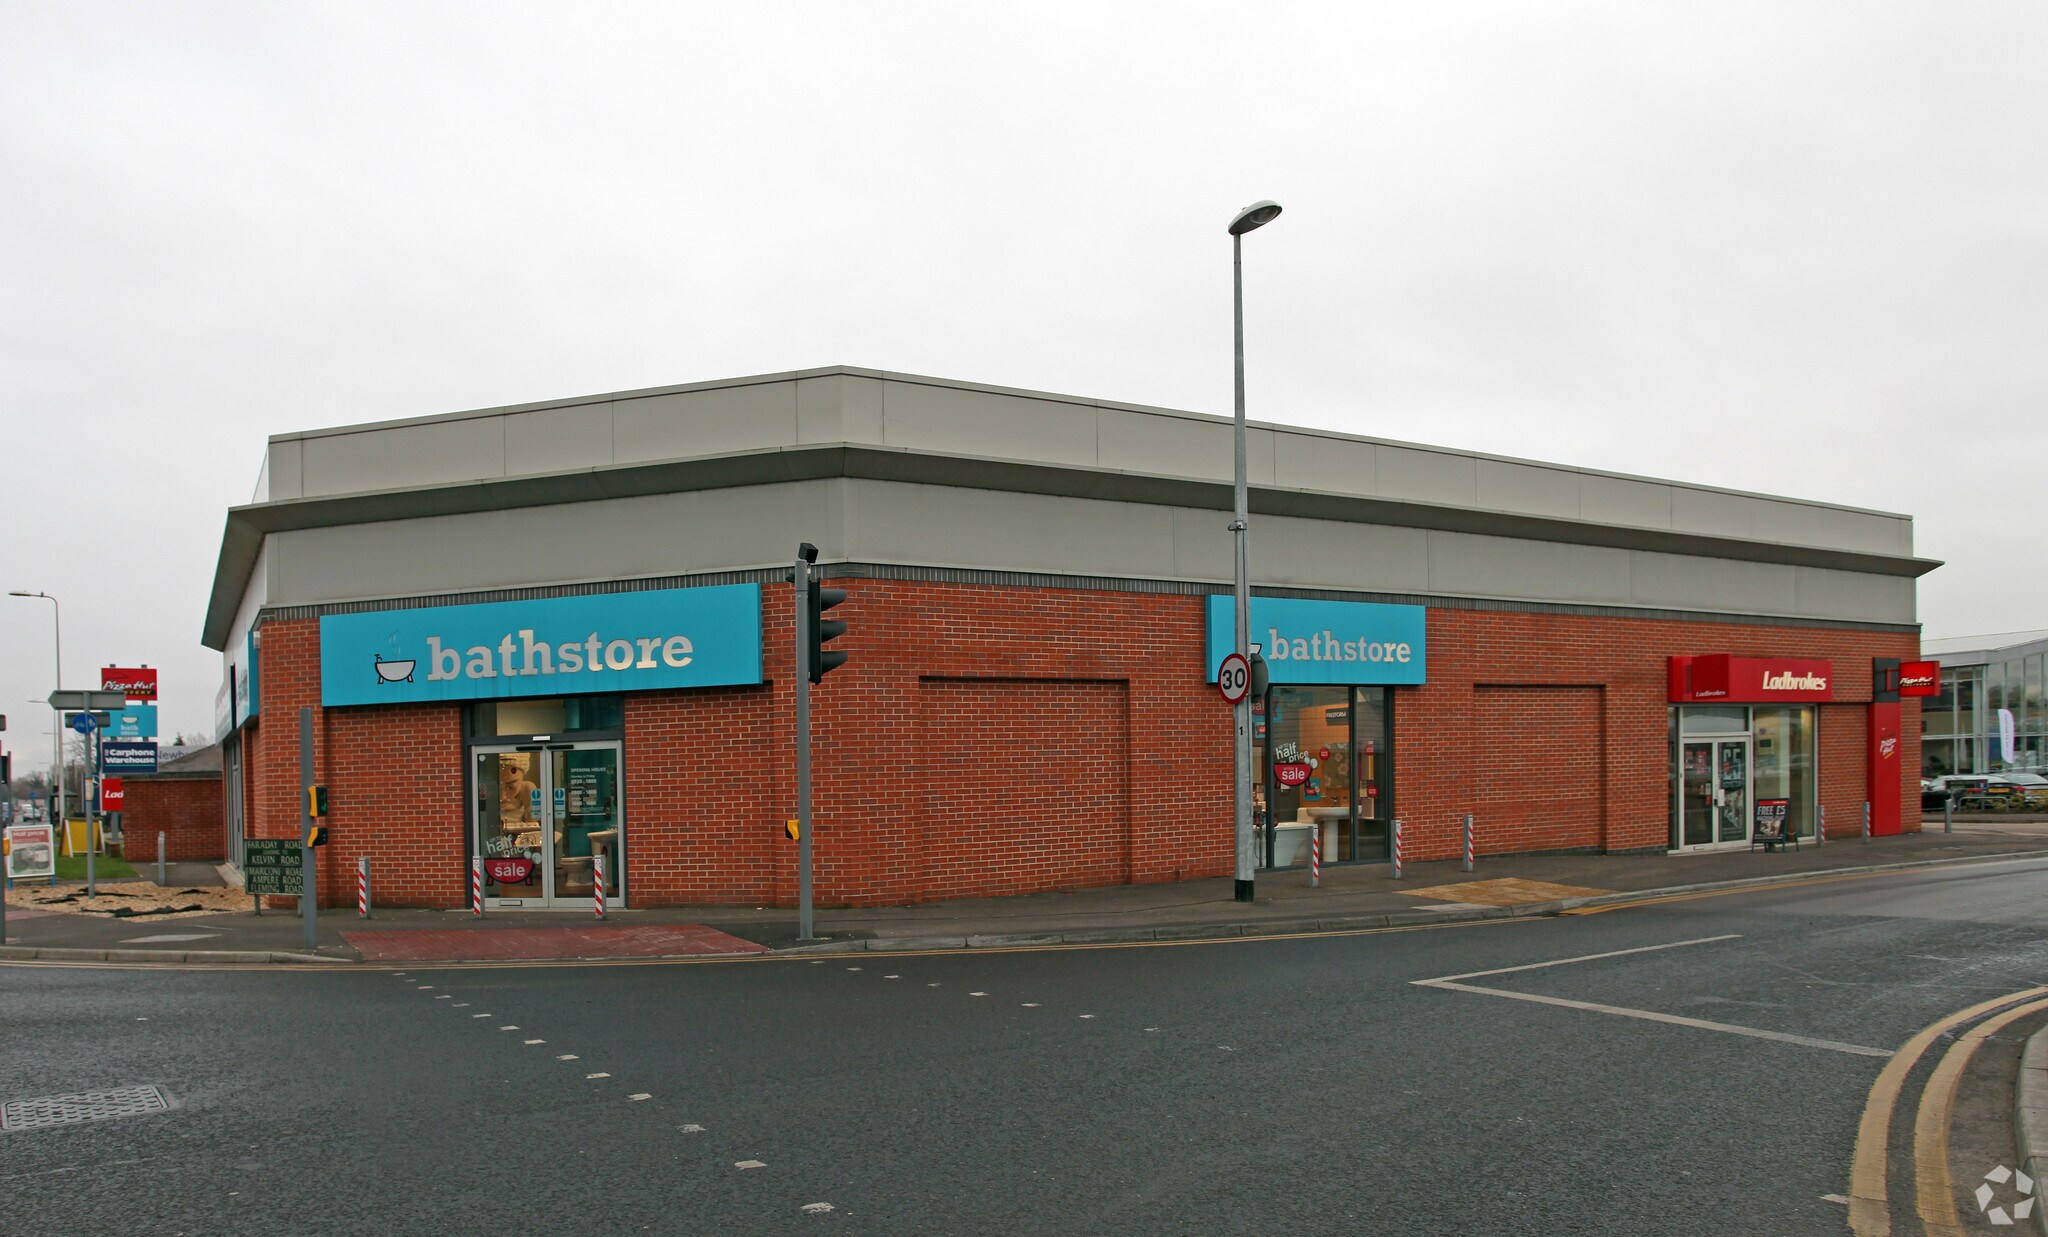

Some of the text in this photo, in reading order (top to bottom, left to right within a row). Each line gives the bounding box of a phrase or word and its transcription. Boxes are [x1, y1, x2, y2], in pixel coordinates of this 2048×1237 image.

[1269, 628, 1411, 663] bathstore
[427, 629, 694, 681] bathstore
[1222, 667, 1246, 690] 30
[1762, 671, 1827, 691] Ladbrokes
[102, 680, 156, 691] Pizza Hut
[1239, 726, 1243, 736] 1
[110, 749, 155, 757] Carphone
[1275, 741, 1297, 760] half
[1288, 750, 1309, 763] price
[1281, 767, 1305, 780] sale
[105, 790, 124, 799] Lad
[1757, 806, 1773, 815] FREE
[247, 841, 278, 849] FARADAY
[486, 834, 513, 854] half
[251, 855, 300, 865] KELVIN ROAD
[248, 867, 281, 876] MARCONI
[494, 863, 526, 877] sale
[252, 876, 302, 885] AMPERE ROAD
[250, 884, 304, 893] FLEMING ROAD
